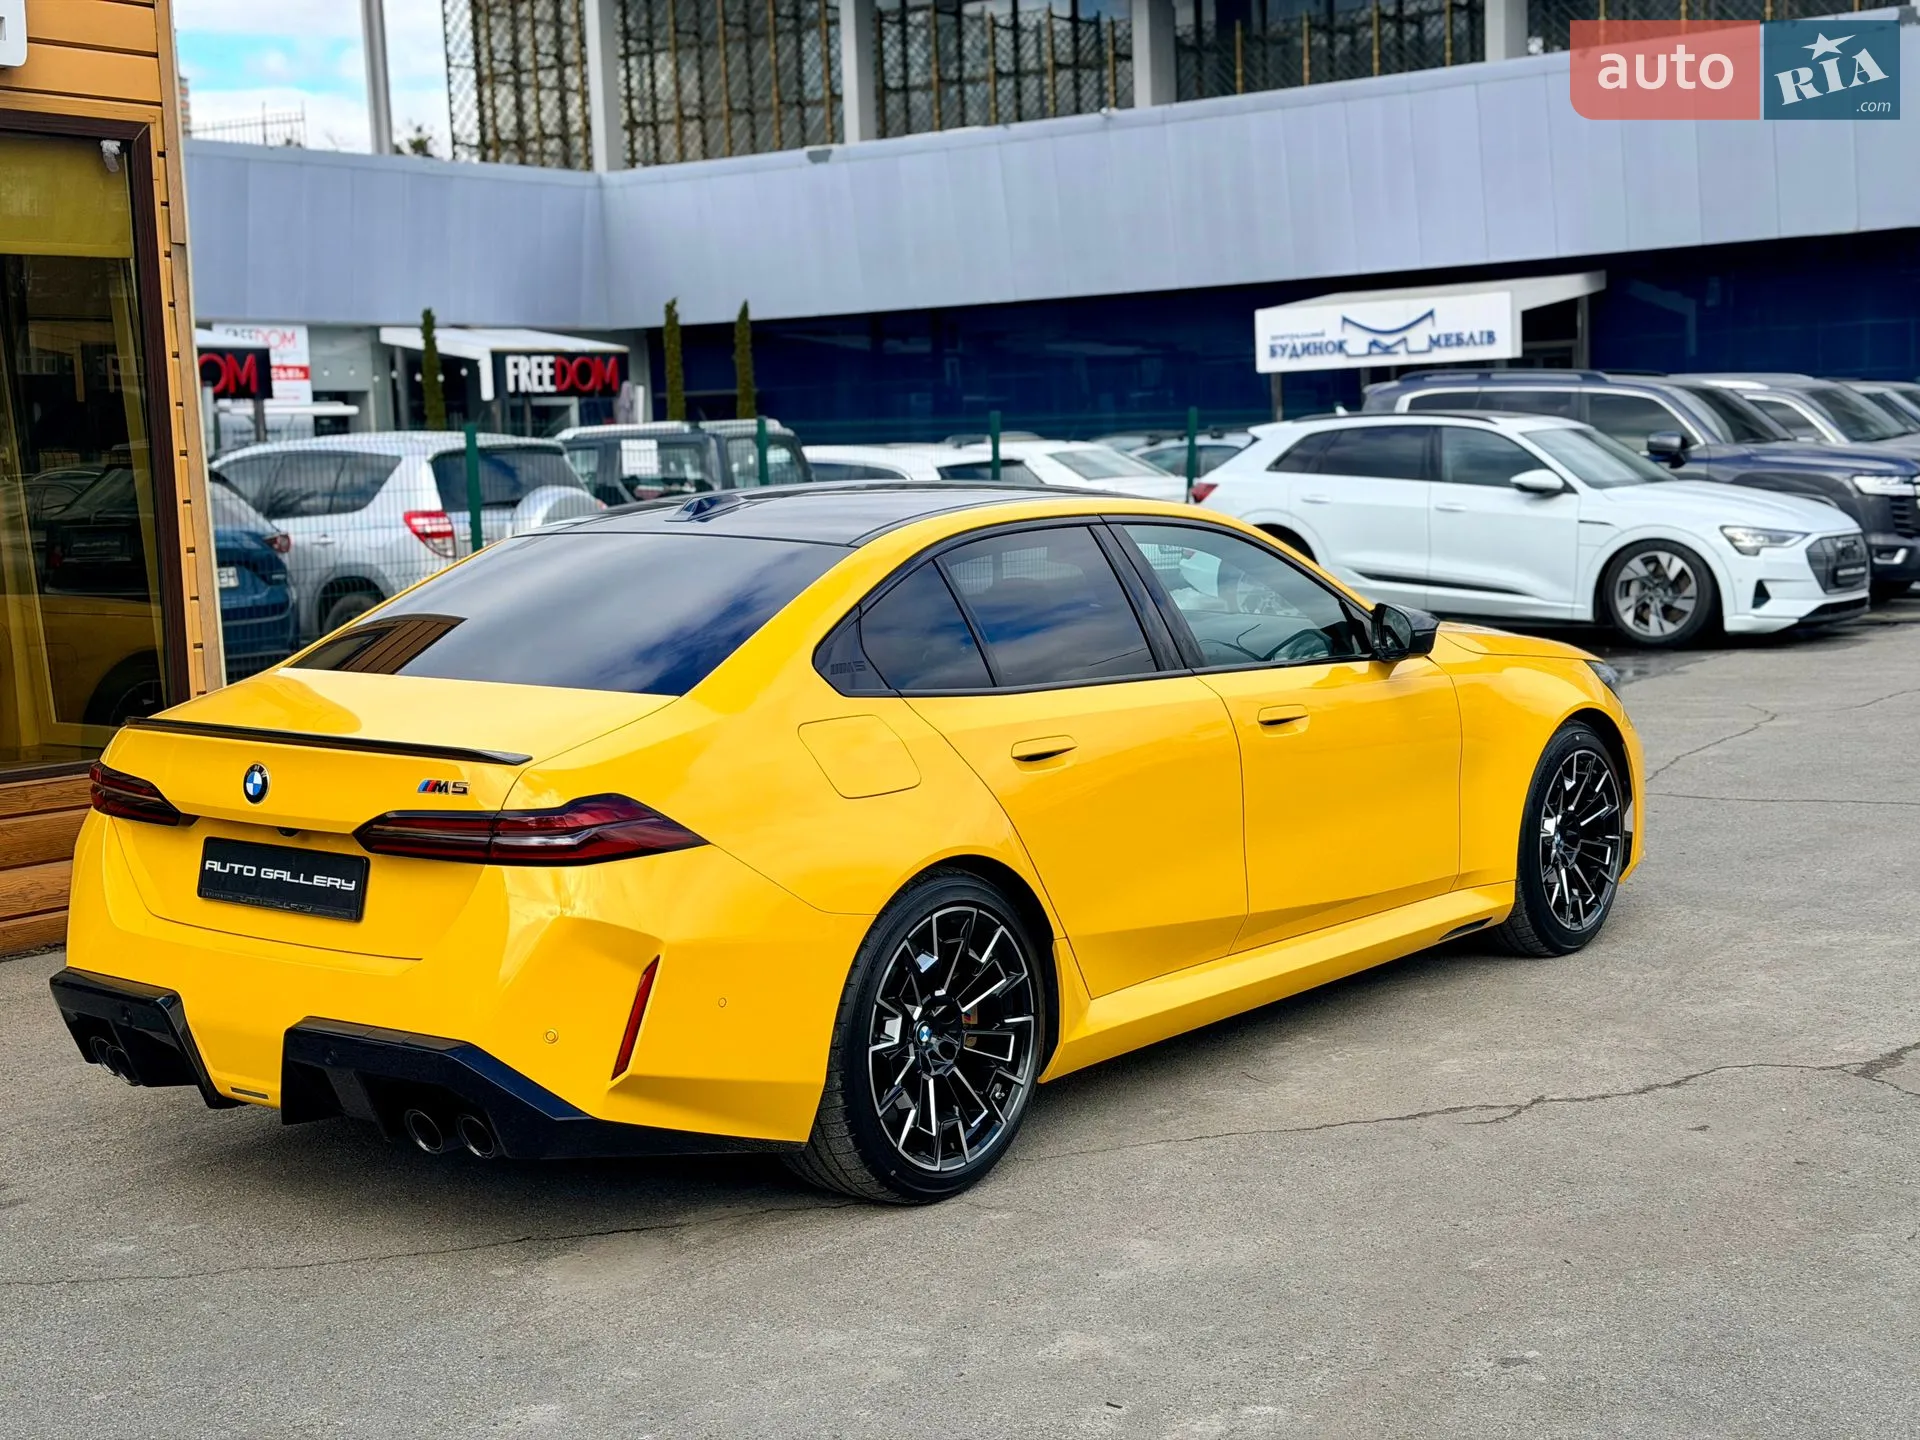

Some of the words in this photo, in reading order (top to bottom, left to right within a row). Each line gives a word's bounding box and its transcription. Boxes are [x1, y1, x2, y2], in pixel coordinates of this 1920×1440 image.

[1269, 339, 1348, 359] БУДИНОК
[1428, 330, 1497, 349] МЕБЛІВ
[505, 355, 619, 393] FREEDOM
[431, 779, 470, 795] M5
[204, 860, 256, 876] AUTO
[260, 868, 356, 891] GALLERY
